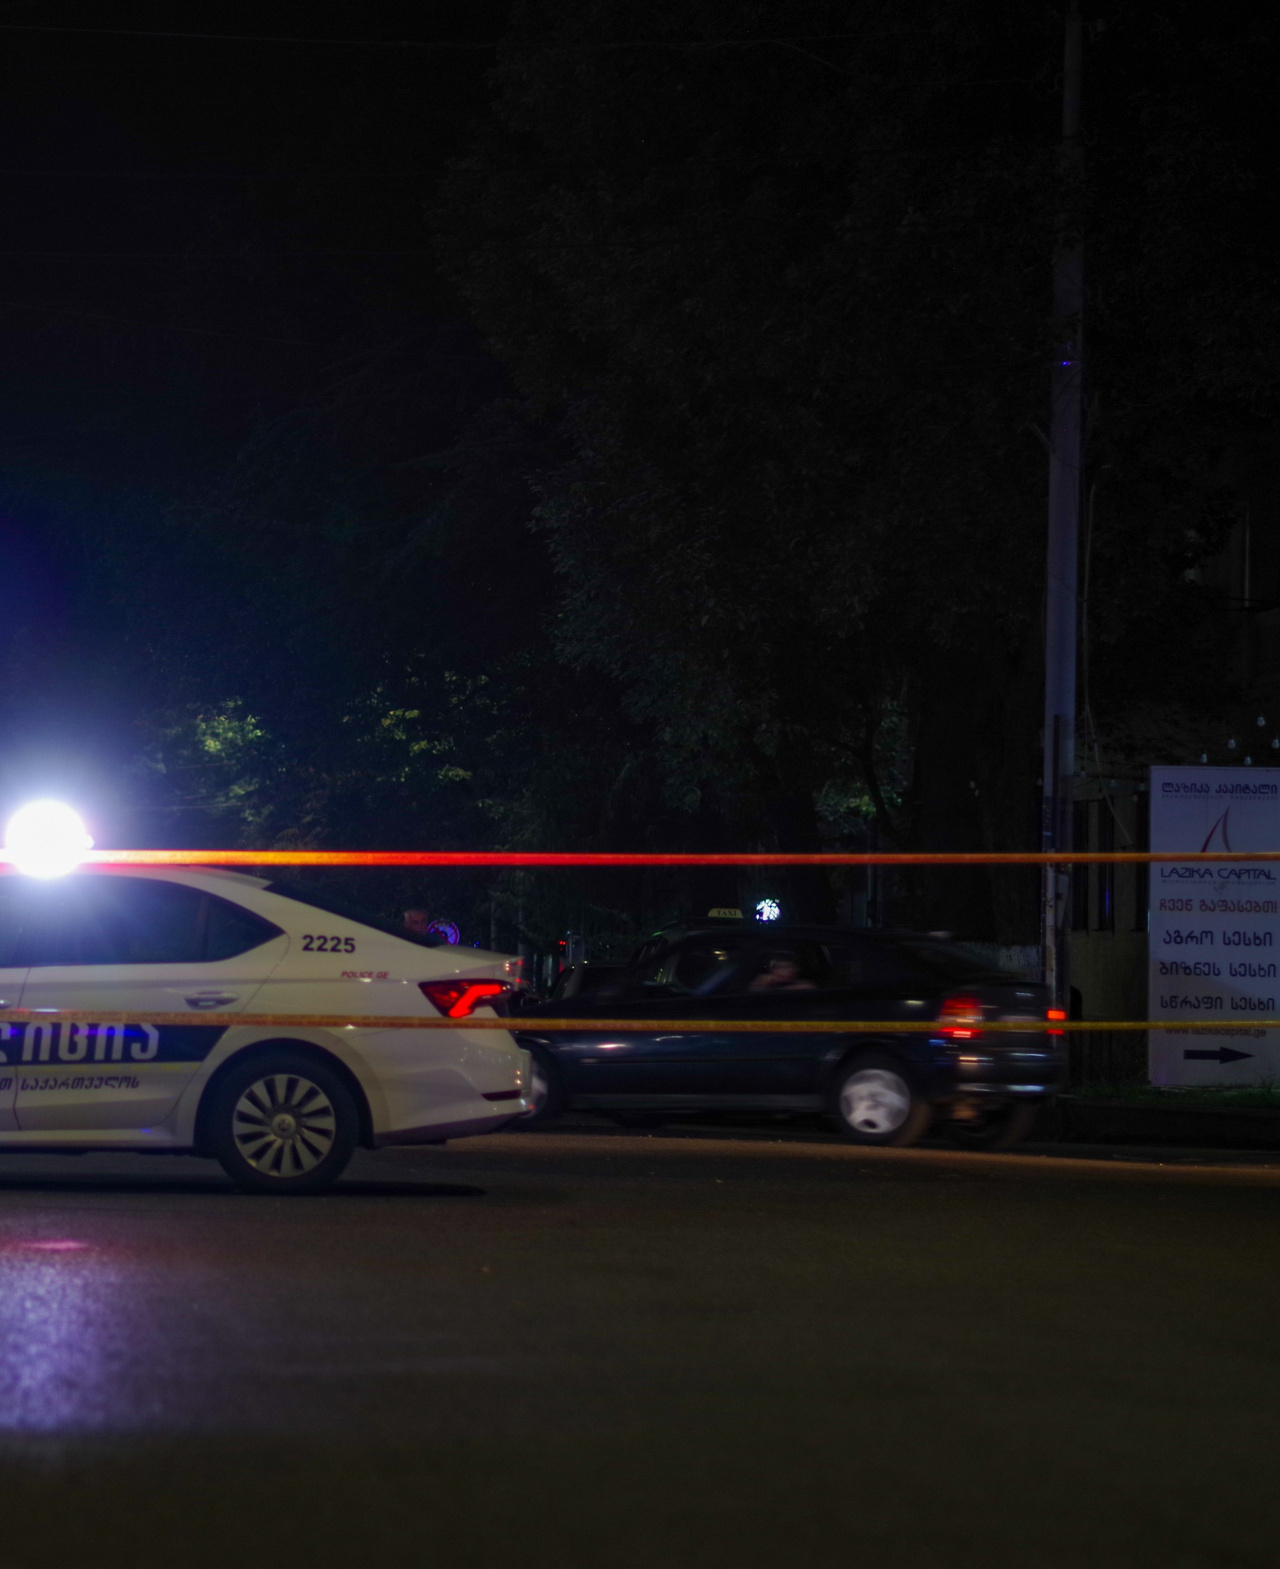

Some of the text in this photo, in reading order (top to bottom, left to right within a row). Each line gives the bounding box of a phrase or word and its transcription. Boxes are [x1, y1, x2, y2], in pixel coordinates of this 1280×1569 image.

[1162, 782, 1278, 795] ლაზიკა კაპიტალი
[1161, 867, 1277, 880] LAZIKA CAPITAL
[1160, 899, 1193, 912] ჩვენ
[302, 935, 356, 953] 2225
[1163, 930, 1273, 946] აგრო სესხი
[1160, 961, 1277, 978] ბიზნეს სესხი
[1160, 995, 1275, 1011] სწრაფი სესხი
[20, 1075, 141, 1092] საქართველოს
